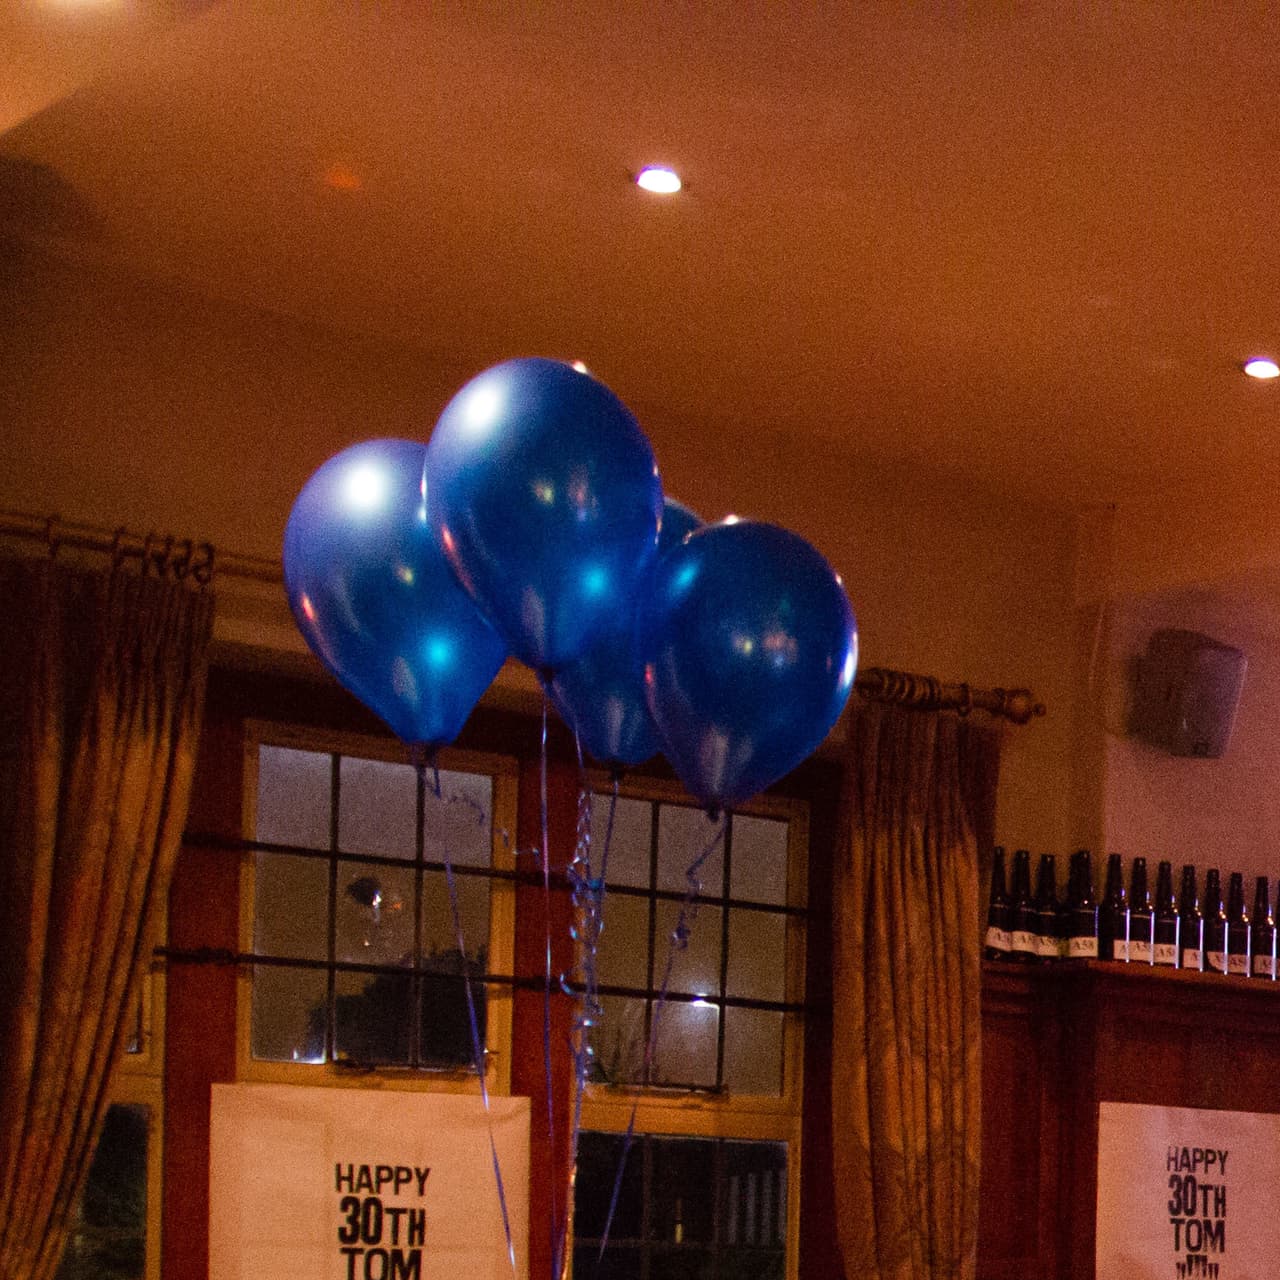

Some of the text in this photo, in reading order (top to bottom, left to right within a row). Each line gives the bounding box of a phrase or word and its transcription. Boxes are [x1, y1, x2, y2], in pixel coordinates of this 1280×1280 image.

[1167, 1146, 1229, 1176] HAPPY
[336, 1164, 431, 1197] HAPPY
[1168, 1175, 1227, 1218] 30TH
[338, 1196, 427, 1247] 30TH
[1170, 1218, 1226, 1253] TOM
